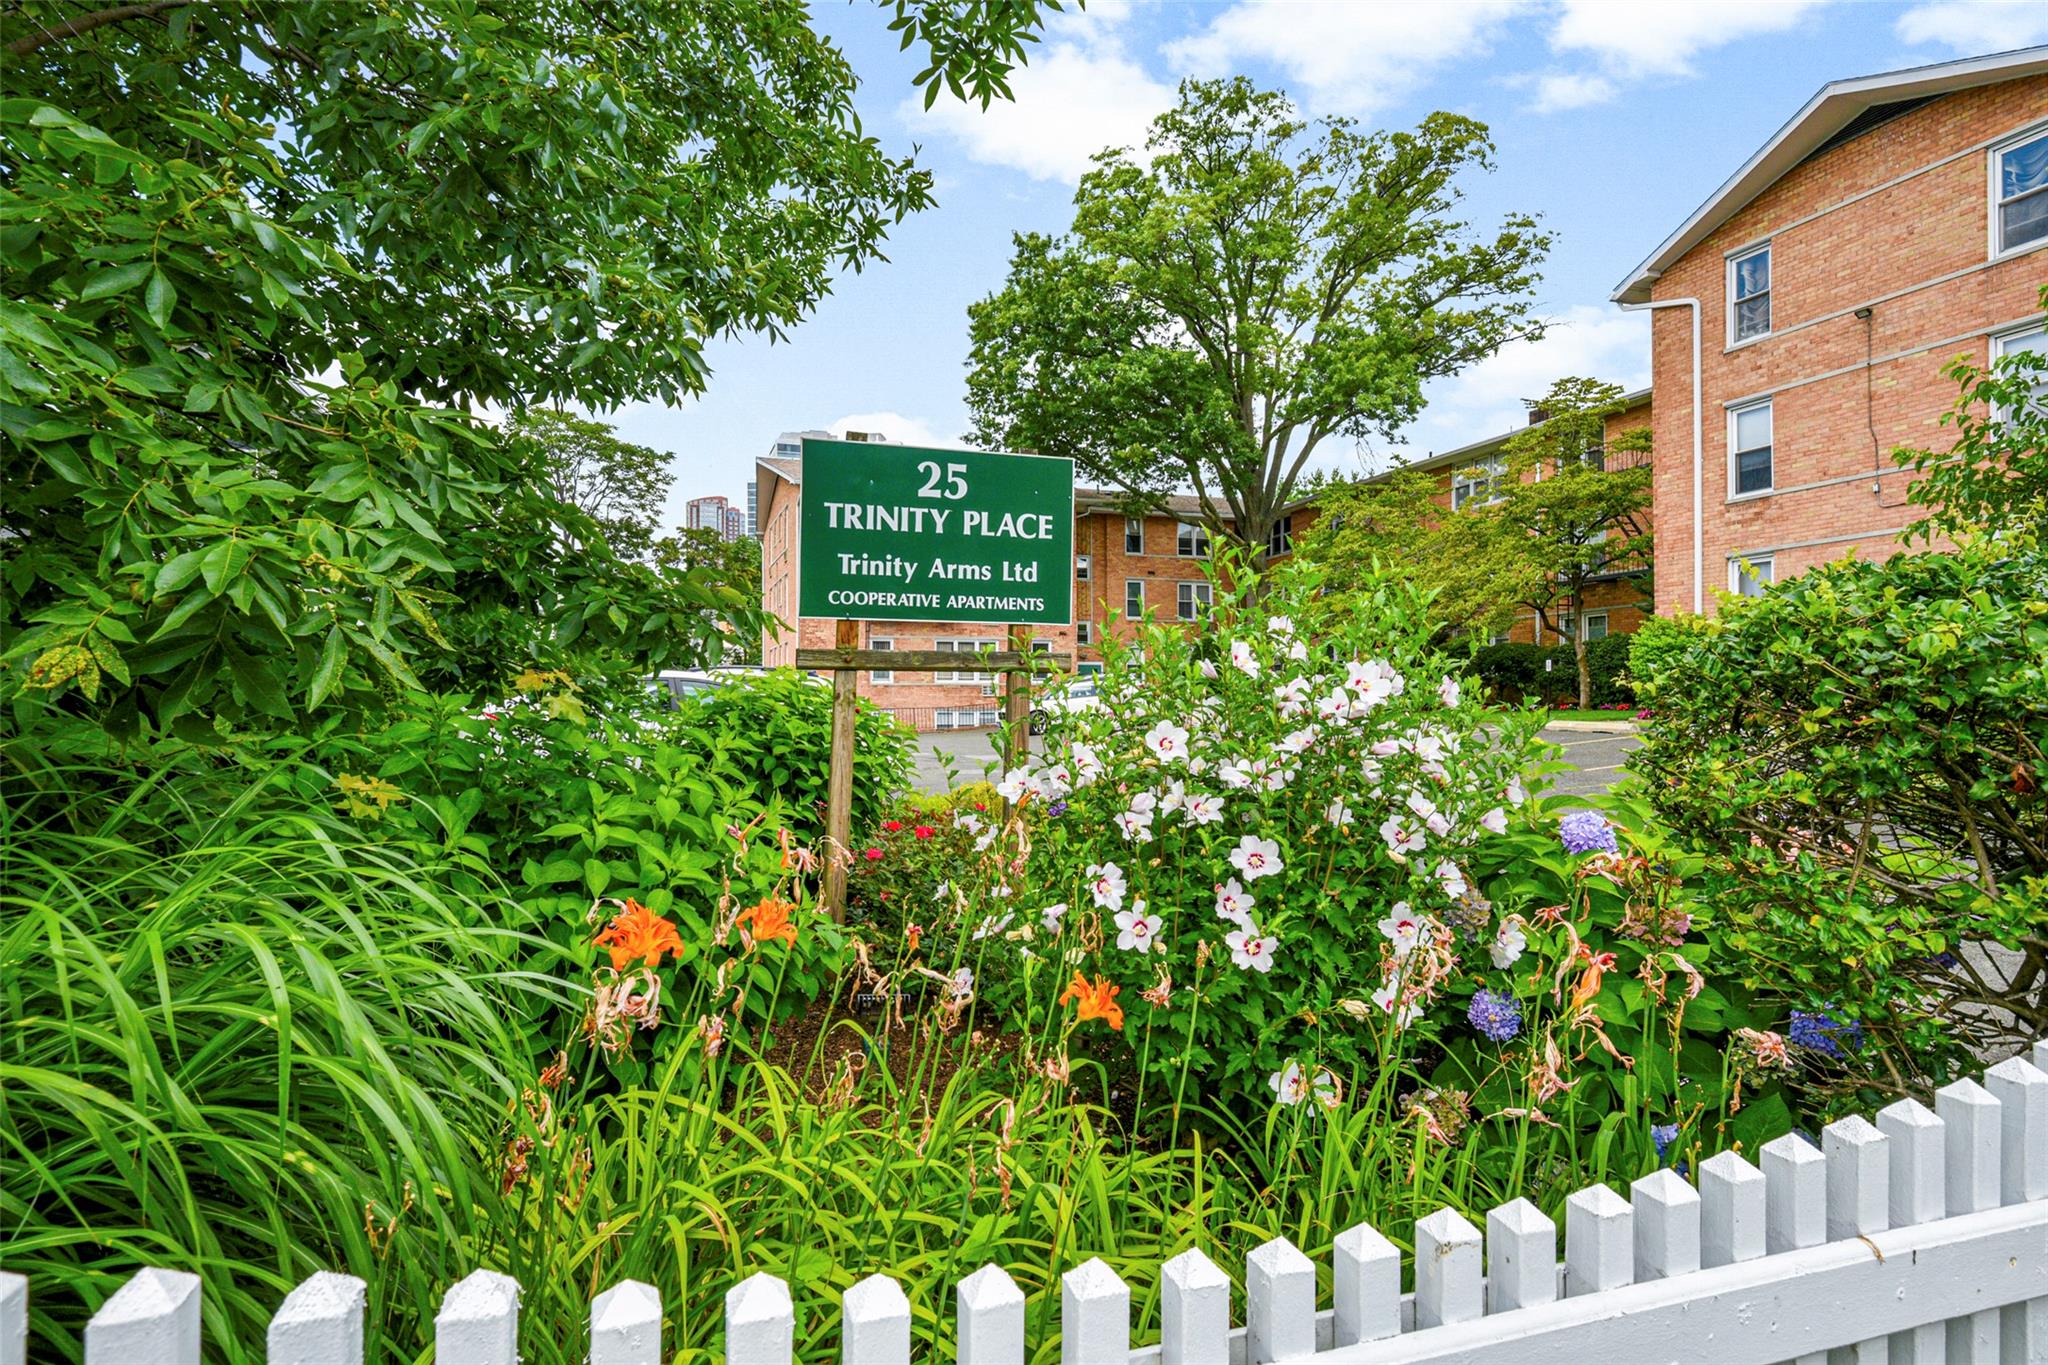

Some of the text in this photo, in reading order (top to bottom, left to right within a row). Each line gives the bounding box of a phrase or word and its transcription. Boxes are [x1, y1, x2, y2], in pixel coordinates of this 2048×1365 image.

[917, 461, 968, 500] 25
[823, 501, 1053, 540] TRINITY PLACE
[837, 553, 1038, 584] Trinity Arms Ltd
[828, 590, 1045, 612] COOPERATIVE APARTMENTS
